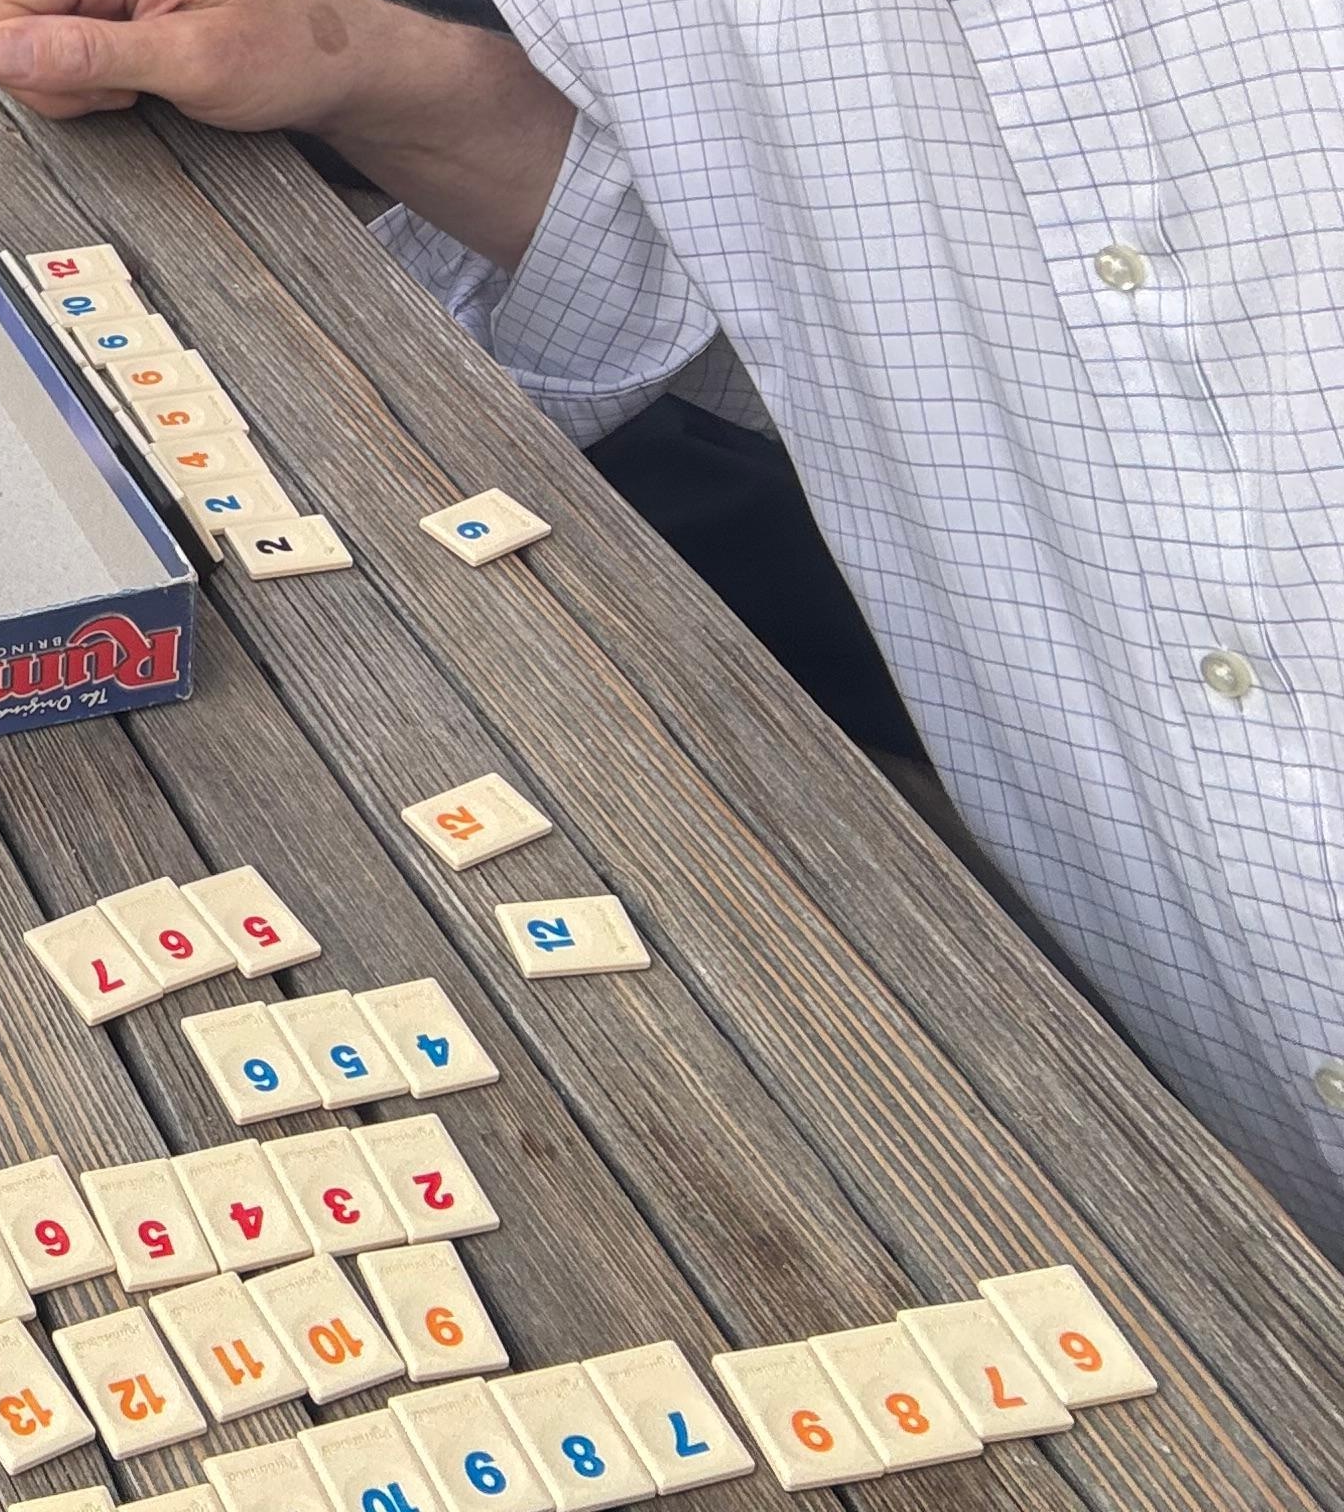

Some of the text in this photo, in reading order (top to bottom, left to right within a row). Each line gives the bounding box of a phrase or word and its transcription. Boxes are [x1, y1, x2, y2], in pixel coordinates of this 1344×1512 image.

[47, 258, 79, 279] 12
[63, 297, 92, 316] 10
[99, 335, 127, 349] 6
[133, 371, 162, 385] 6
[159, 411, 190, 426] 5
[178, 452, 207, 468] 4
[206, 496, 240, 511] 2
[255, 536, 293, 554] 2
[457, 521, 488, 539] 9
[79, 687, 109, 709] The
[436, 807, 483, 841] 12
[159, 929, 194, 960] 6
[242, 915, 280, 948] 5
[527, 919, 573, 952] 12
[91, 958, 125, 994] 7
[330, 1045, 367, 1078] 5
[417, 1034, 449, 1067] 4
[243, 1059, 279, 1092] 6
[322, 1187, 361, 1225] 3
[412, 1171, 455, 1211] 2
[34, 1219, 71, 1257] 6
[229, 1202, 263, 1240] 4
[137, 1220, 175, 1259] 5
[308, 1319, 364, 1365] 10
[425, 1307, 464, 1347] 9
[212, 1339, 265, 1386] 11
[1059, 1332, 1102, 1372] 6
[108, 1375, 166, 1421] 12
[986, 1367, 1024, 1409] 7
[791, 1410, 834, 1453] 9
[885, 1393, 930, 1435] 8
[668, 1412, 708, 1457] 7
[464, 1451, 506, 1495] 9
[561, 1435, 605, 1478] 8
